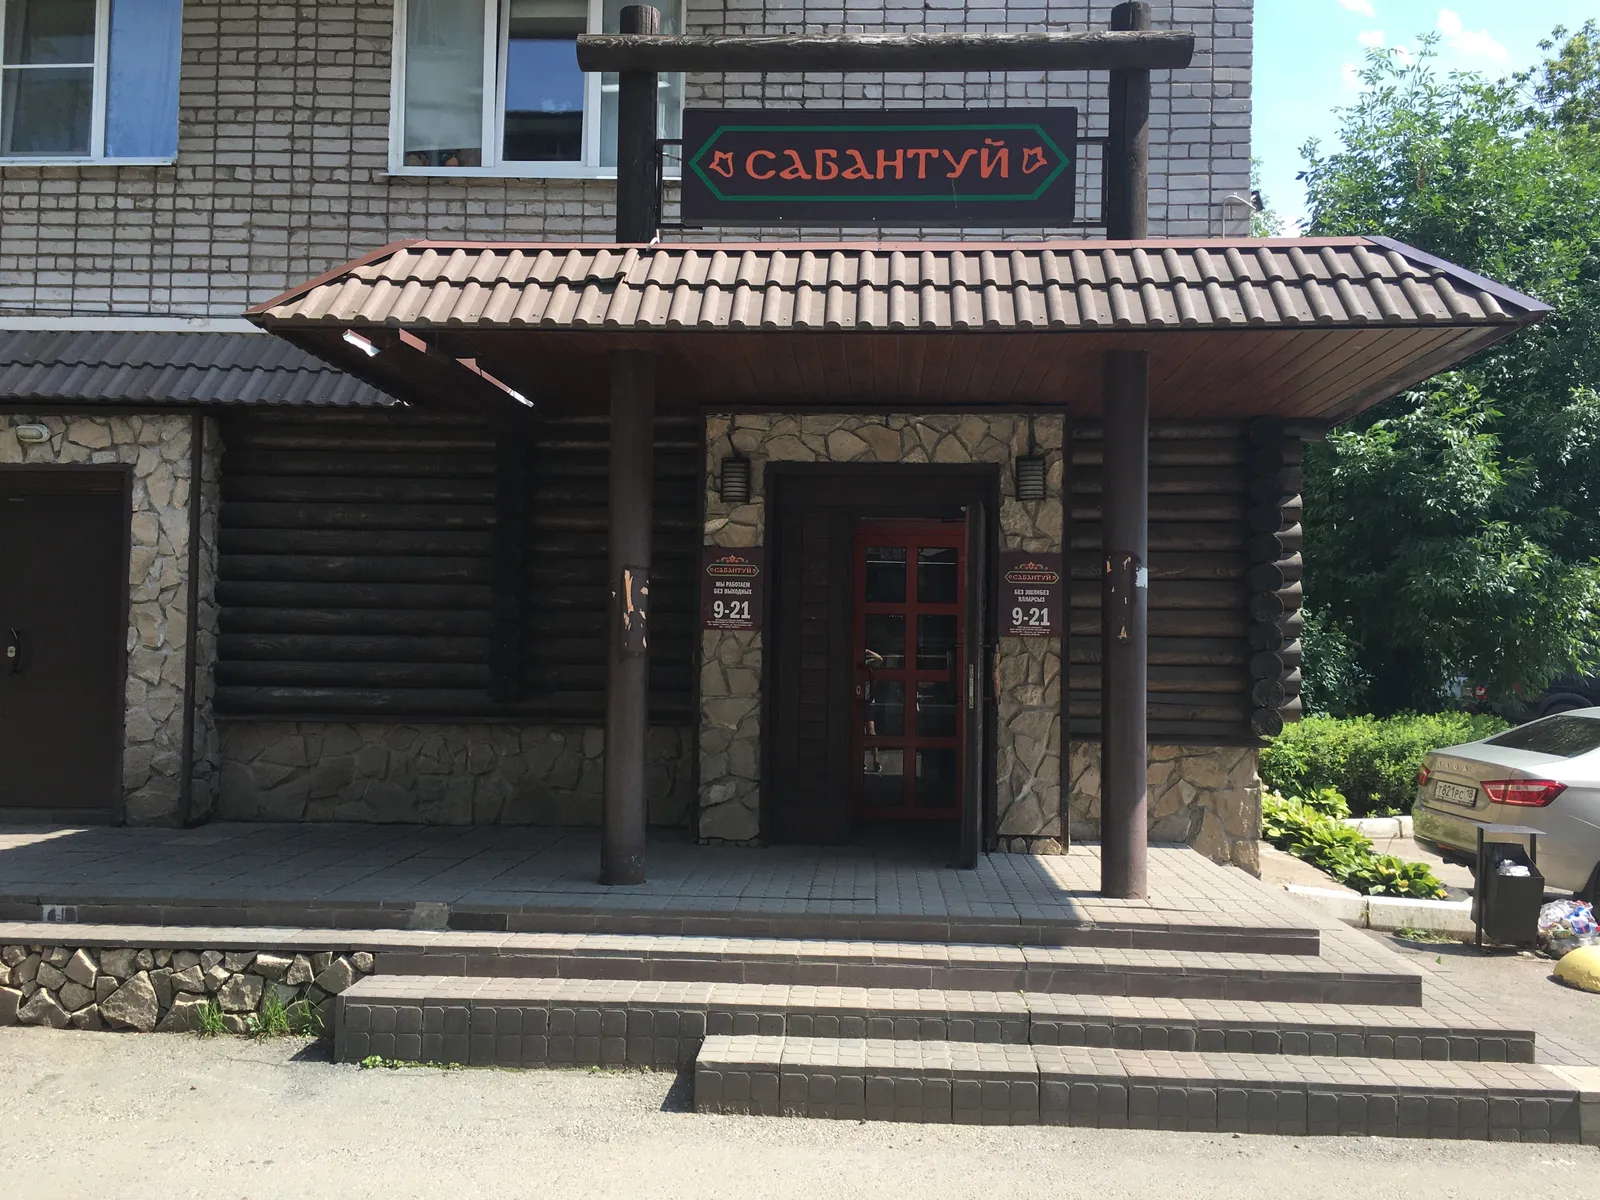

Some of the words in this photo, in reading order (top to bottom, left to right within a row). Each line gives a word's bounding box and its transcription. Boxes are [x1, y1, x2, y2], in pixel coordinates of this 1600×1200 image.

[745, 138, 1009, 180] САБАНТУЙ
[713, 566, 752, 574] САБАНТУЙ
[713, 600, 751, 619] 9-21
[1012, 607, 1051, 626] 9-21
